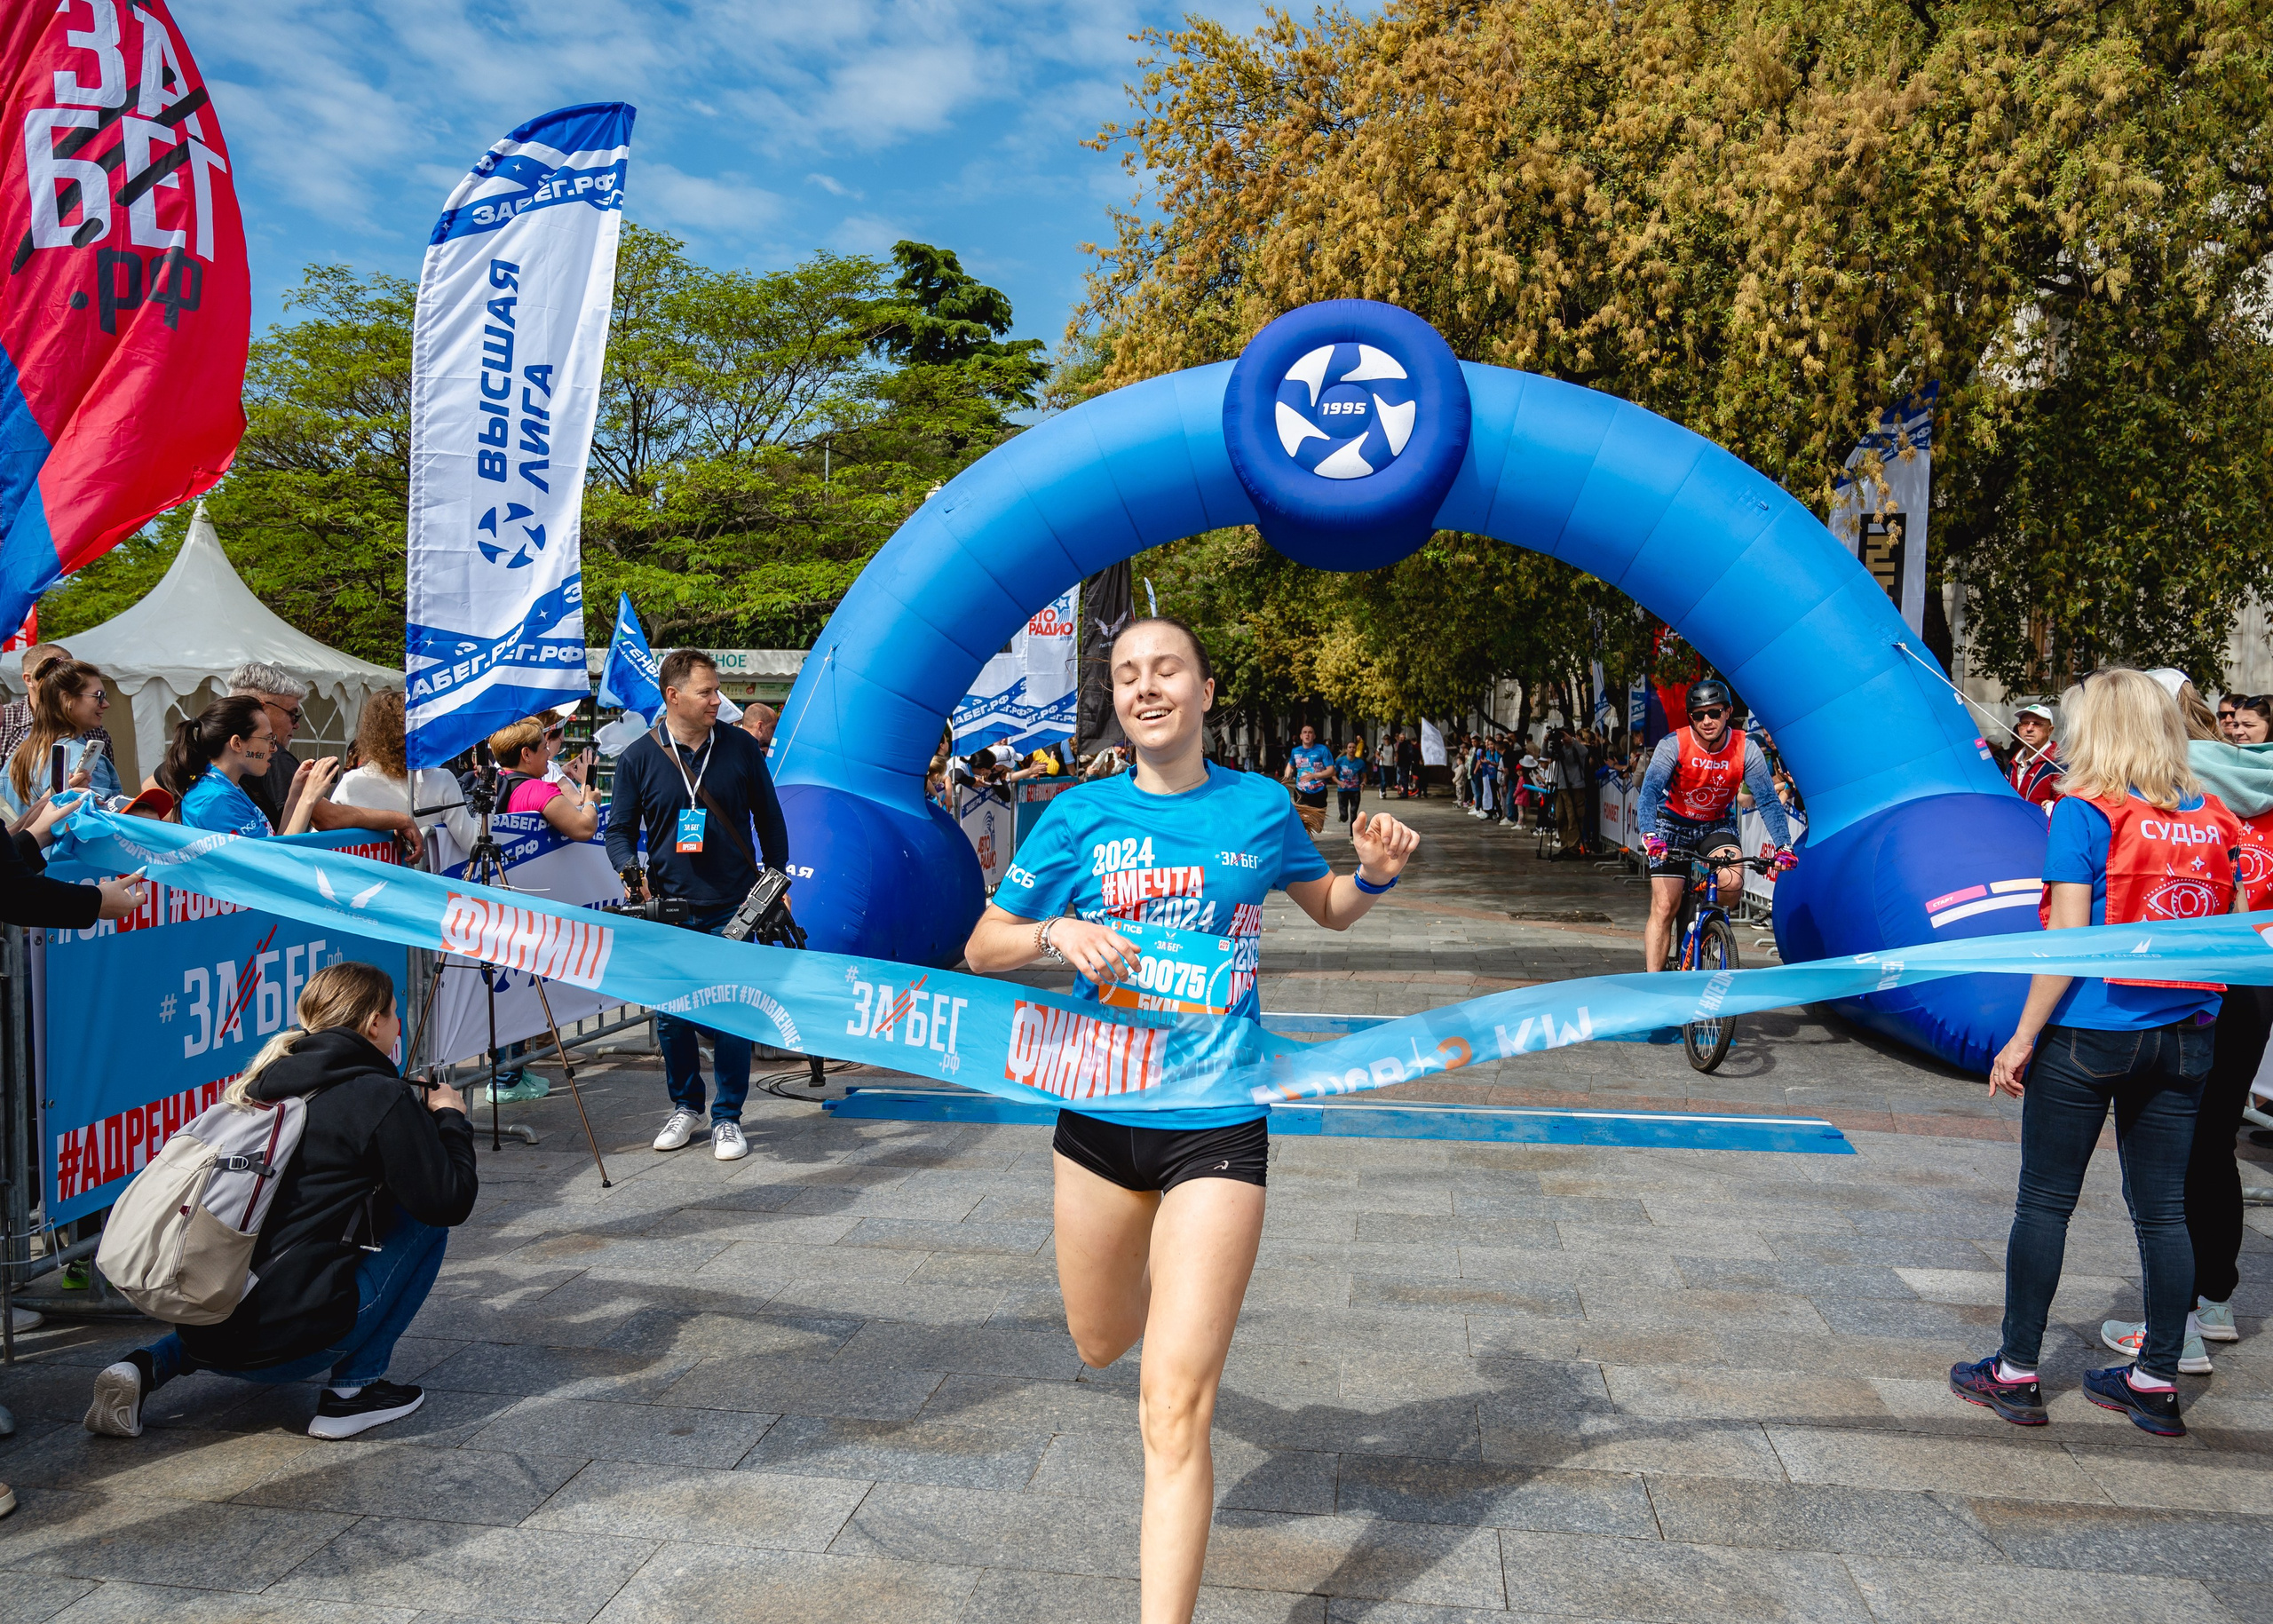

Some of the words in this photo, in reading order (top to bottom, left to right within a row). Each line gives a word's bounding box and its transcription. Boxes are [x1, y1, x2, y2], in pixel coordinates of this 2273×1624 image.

[478, 258, 520, 483] ВЫСШАЯ
[1322, 402, 1366, 415] 1995
[519, 364, 553, 495] ЛИГА
[1028, 622, 1073, 636] РАДИО
[1691, 757, 1730, 770] СУДЬЯ
[2140, 820, 2221, 846] СУДЬЯ
[1092, 836, 1155, 876] 2024
[1005, 862, 1036, 888] ПСБ
[1101, 866, 1205, 906] #МЕЧТА
[1932, 896, 1954, 907] СТАРТ
[1123, 923, 1143, 934] ПСБ
[440, 894, 614, 990] ФИНИШ
[692, 984, 739, 1010] #ТРЕПЕТ
[739, 985, 802, 1048] #УДИВЛЕНИЕ
